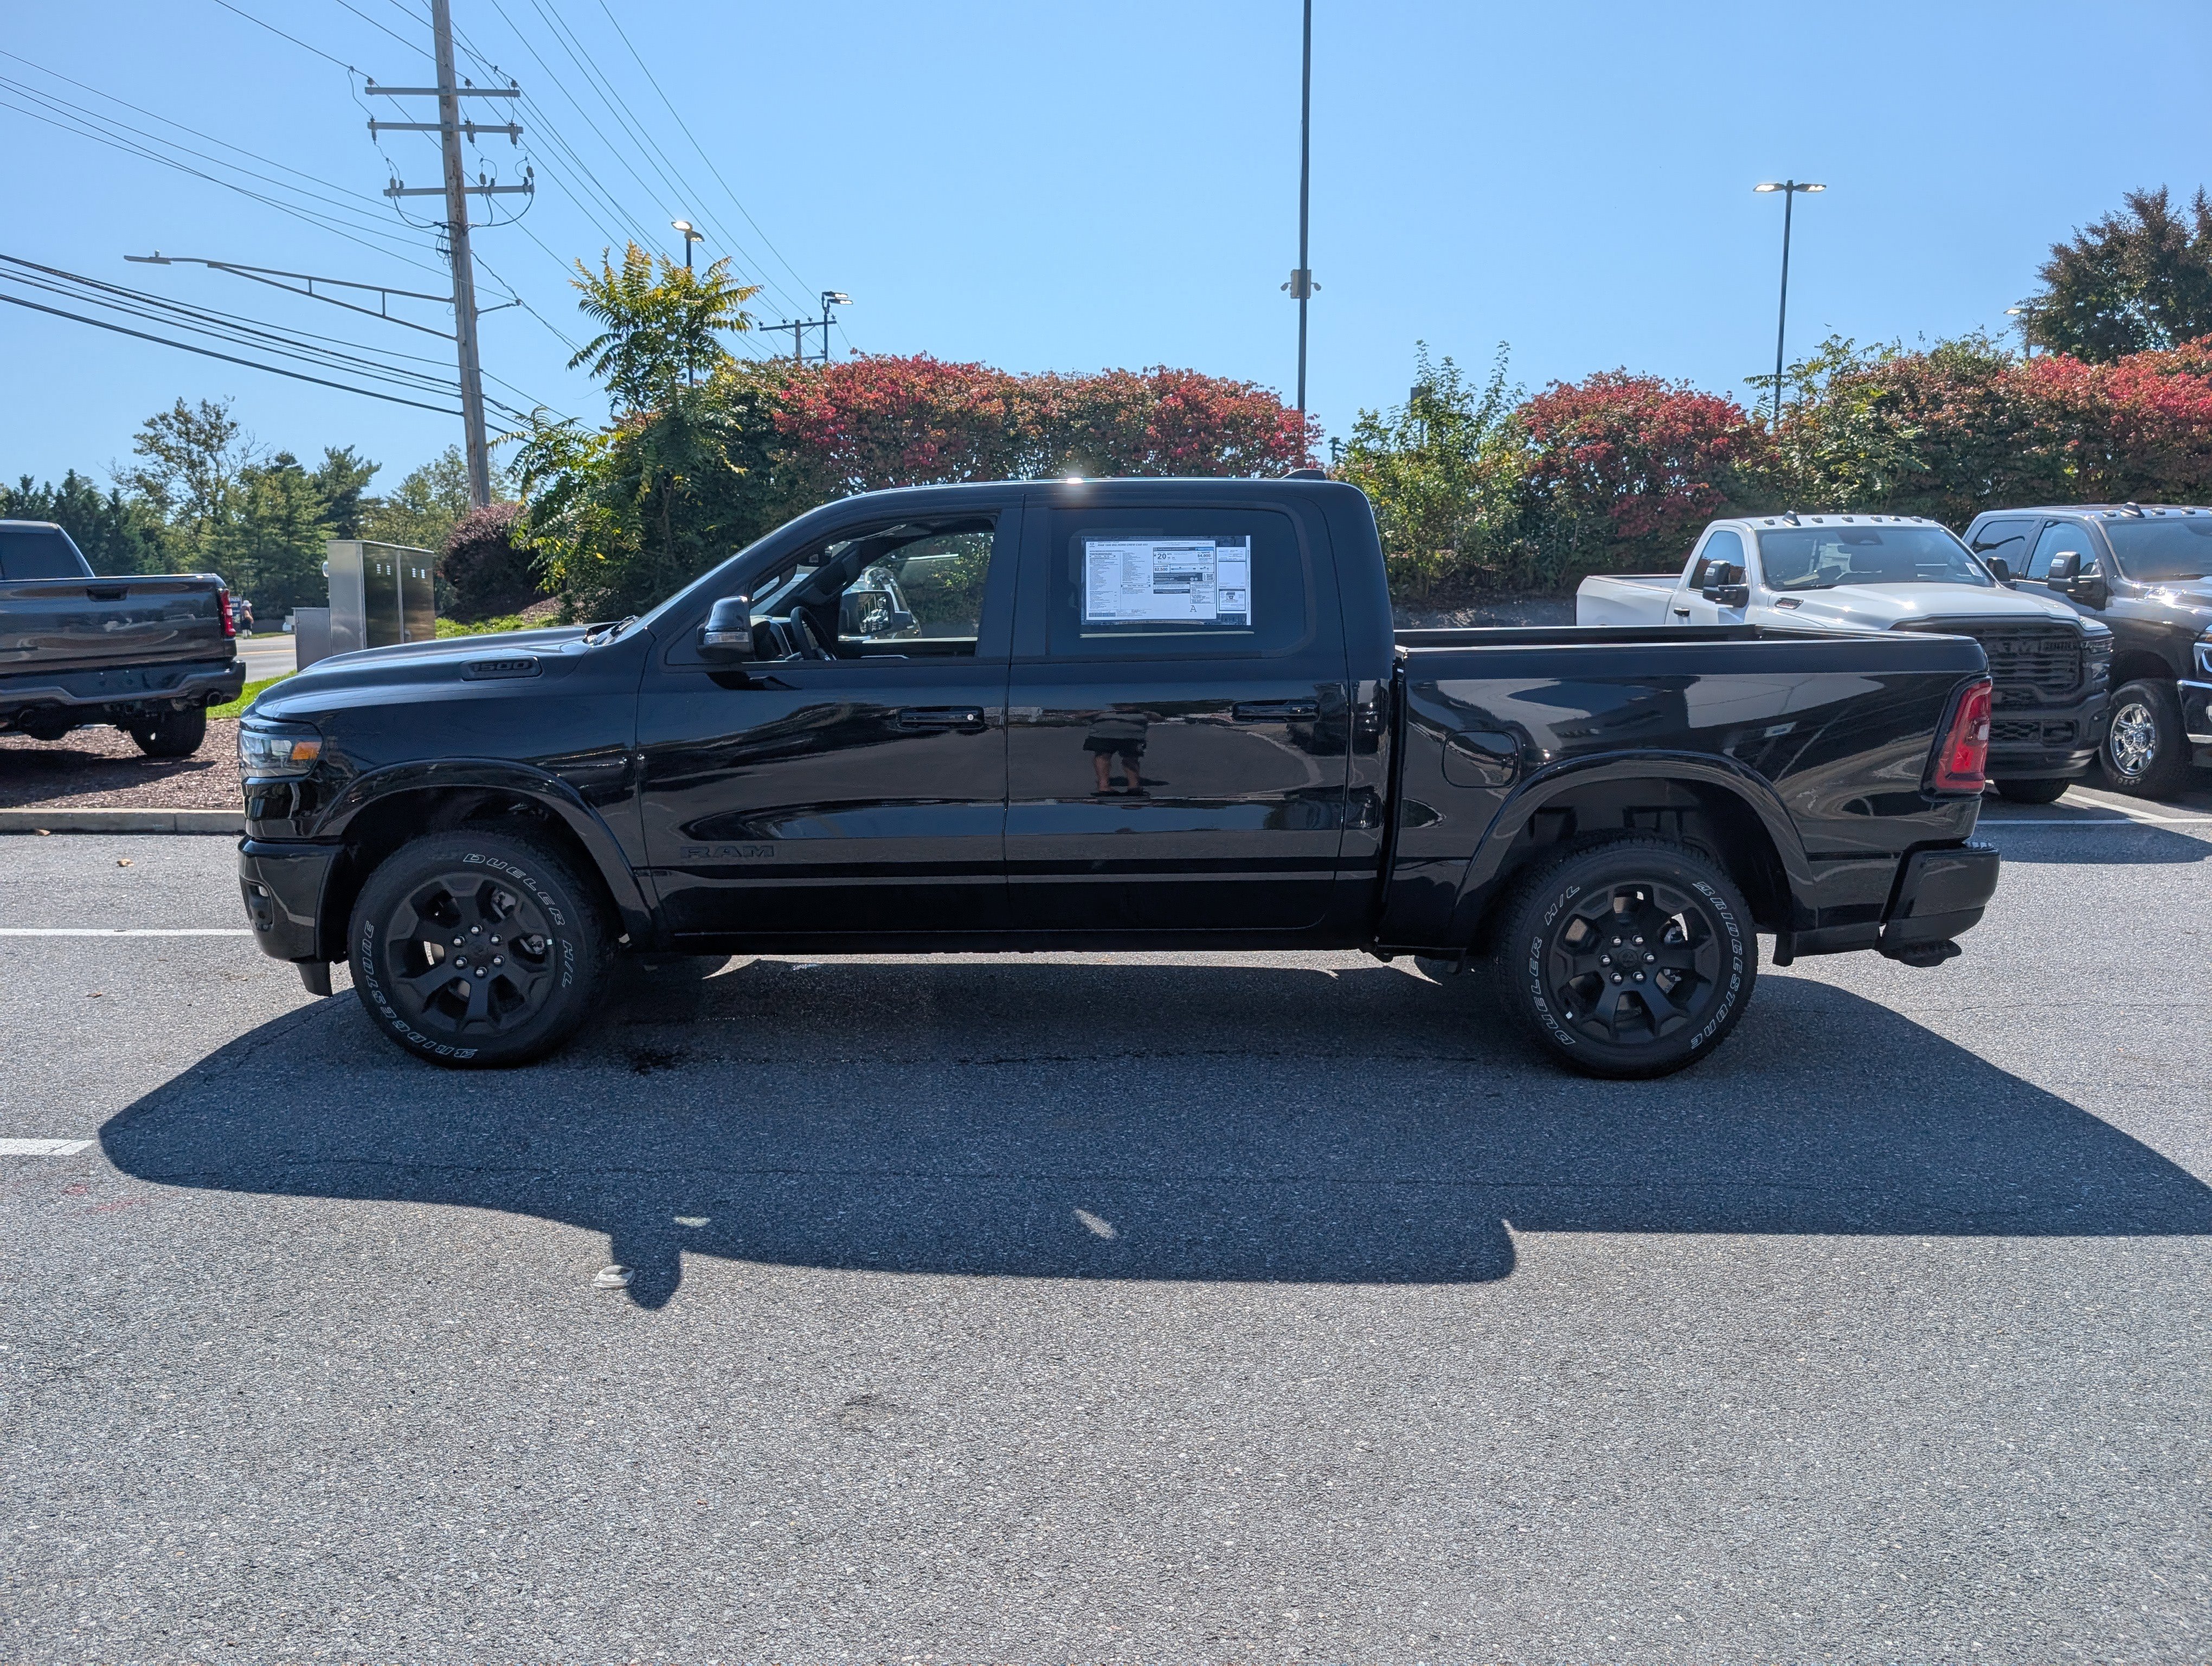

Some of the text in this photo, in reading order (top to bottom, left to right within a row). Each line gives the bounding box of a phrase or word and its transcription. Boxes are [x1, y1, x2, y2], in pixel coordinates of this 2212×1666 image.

[470, 660, 530, 672] 1500
[462, 853, 565, 926] DUELER
[680, 845, 774, 858] RAM
[362, 920, 478, 1059] BRIDGESTONE
[1529, 937, 1576, 1046] DUELER
[1692, 881, 1743, 1049] BRIDGESTONE
